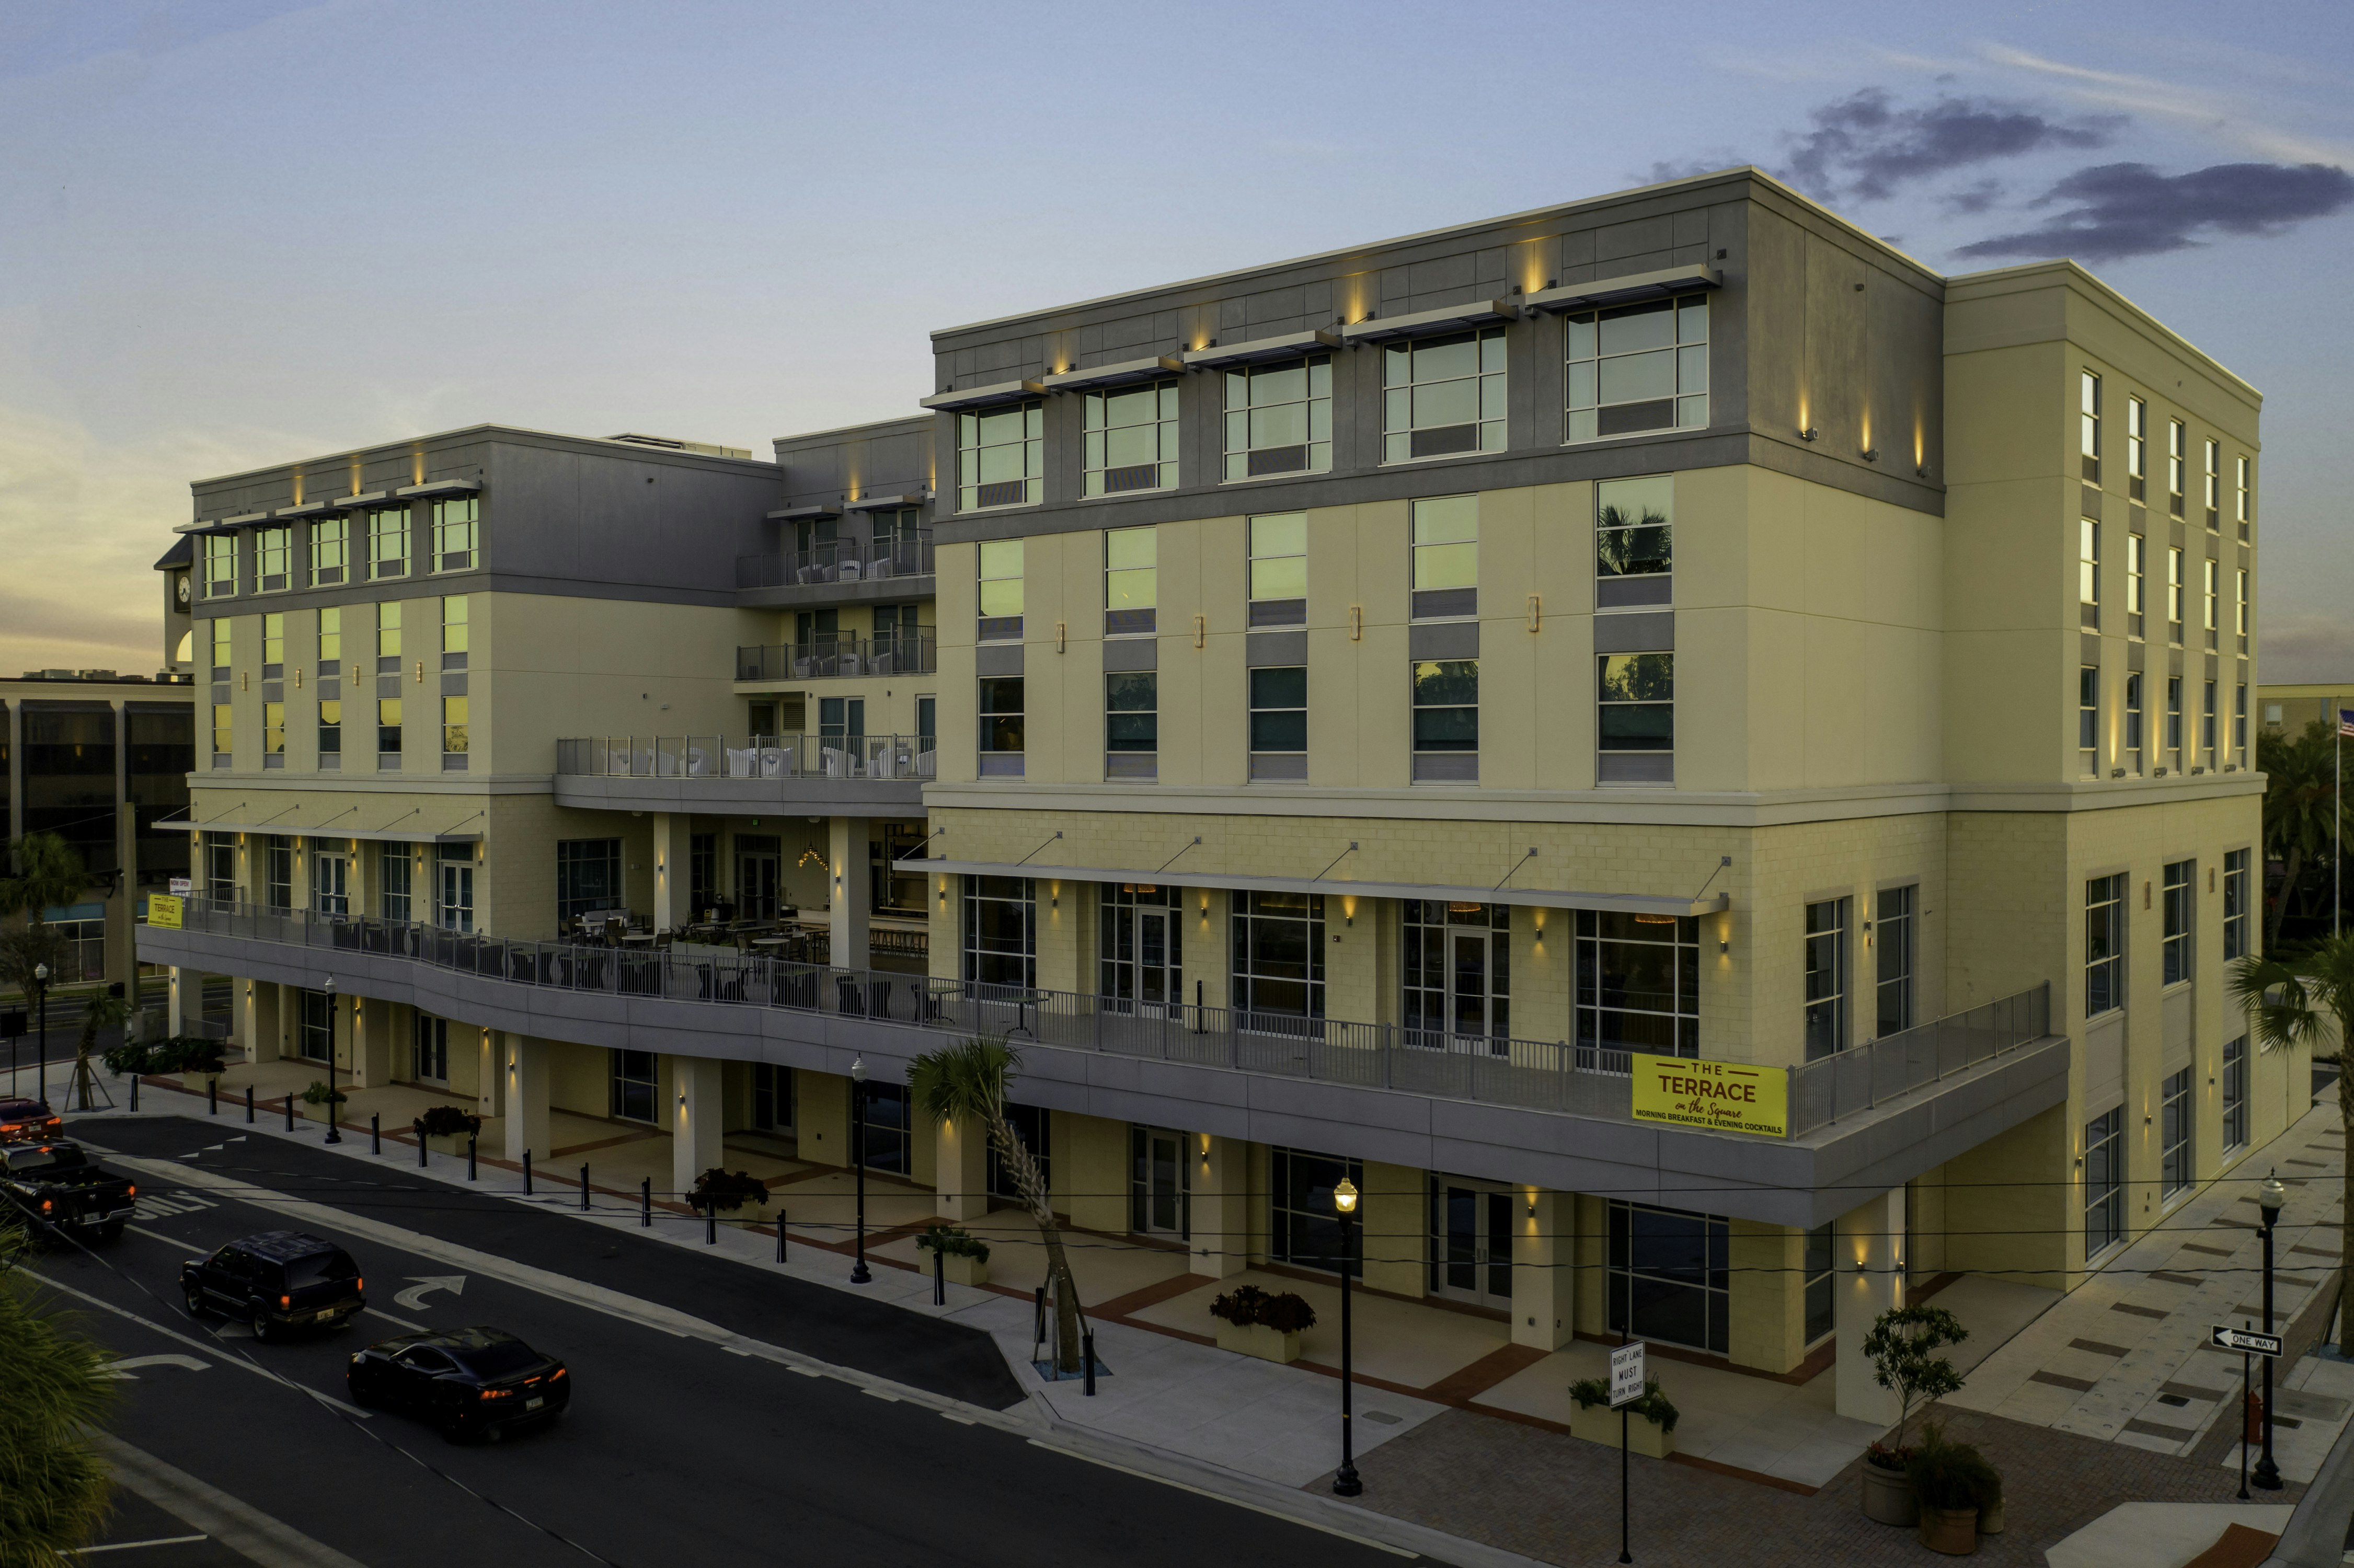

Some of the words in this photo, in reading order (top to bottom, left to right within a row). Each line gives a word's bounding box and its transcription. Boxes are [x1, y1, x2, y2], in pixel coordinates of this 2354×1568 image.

[155, 903, 175, 914] TERRACE
[1691, 1063, 1722, 1076] THE
[1658, 1075, 1756, 1103] TERRACE
[1675, 1102, 1686, 1110] on
[1688, 1098, 1705, 1114] the
[1707, 1102, 1742, 1119] Square
[1636, 1109, 1667, 1120] MORNING
[1668, 1113, 1706, 1124] BREAKFAST
[1714, 1119, 1743, 1129] EVENING
[1744, 1123, 1782, 1134] COCKTAILS
[2233, 1335, 2251, 1345] ONE
[2255, 1338, 2274, 1348] WAY
[1613, 1354, 1627, 1366] RIGHT
[1629, 1348, 1643, 1361] LANE
[1619, 1366, 1637, 1381] MUST
[1613, 1387, 1626, 1399] TURN
[1628, 1380, 1643, 1393] RIGHT
